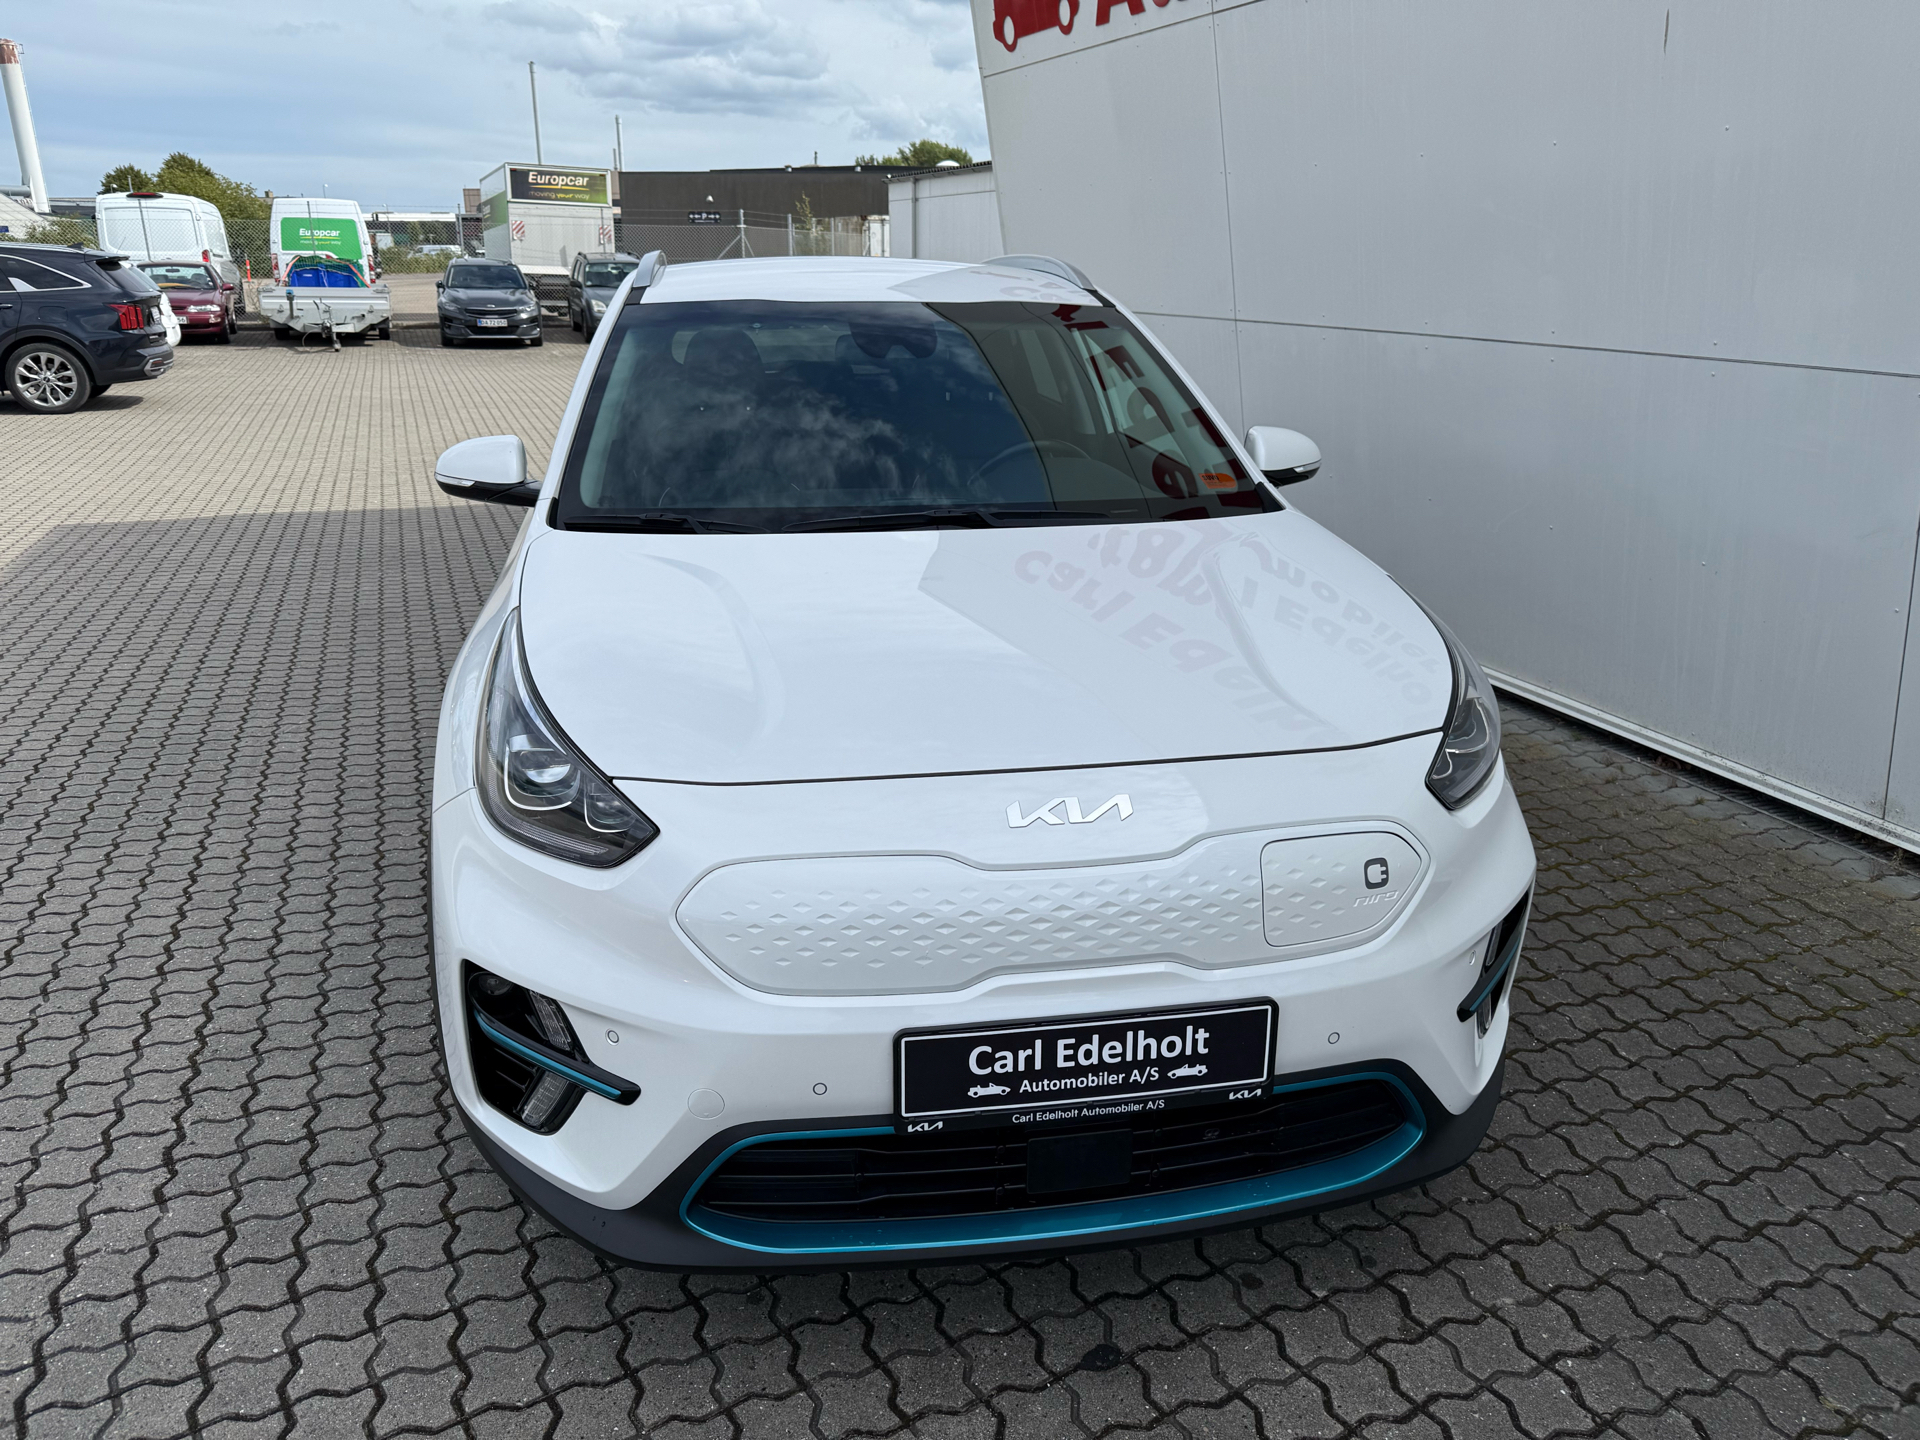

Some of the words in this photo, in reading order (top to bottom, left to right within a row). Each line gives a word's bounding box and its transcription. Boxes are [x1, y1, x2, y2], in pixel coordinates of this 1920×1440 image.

[528, 171, 590, 189] Europcar
[528, 190, 556, 199] moving
[1005, 793, 1134, 828] KIA
[968, 1039, 1042, 1076] Carl
[1056, 1024, 1211, 1068] Edelholt
[1019, 1070, 1125, 1094] Automobiler
[1129, 1066, 1160, 1084] A/S
[1228, 1087, 1262, 1101] KIA
[1012, 1113, 1034, 1124] Carl
[1036, 1108, 1079, 1122] Edelholt
[1080, 1101, 1145, 1119] Automobiler
[1146, 1098, 1166, 1111] A/S
[907, 1120, 944, 1133] KIA
